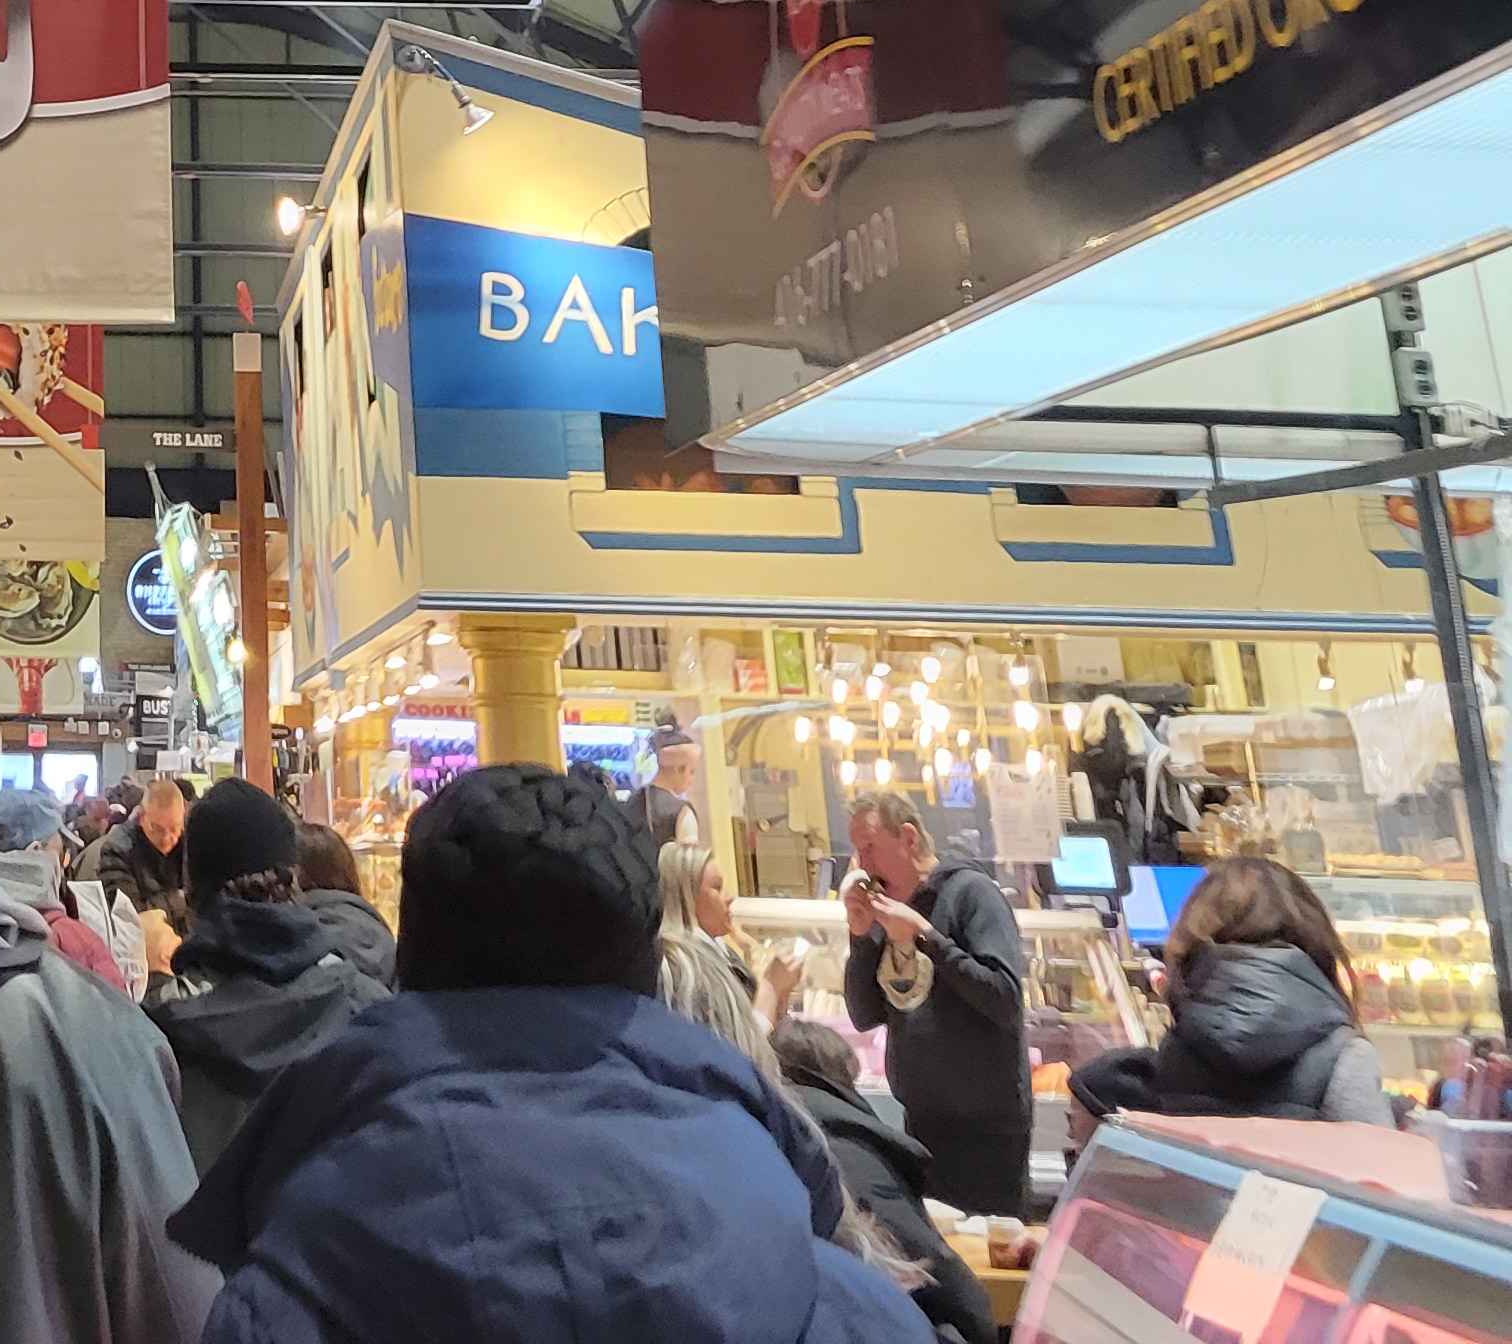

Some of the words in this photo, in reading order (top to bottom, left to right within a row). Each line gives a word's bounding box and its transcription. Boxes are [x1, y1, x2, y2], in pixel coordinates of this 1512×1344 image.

[152, 432, 182, 446] THE
[185, 433, 223, 447] LANE
[142, 699, 172, 715] BUS
